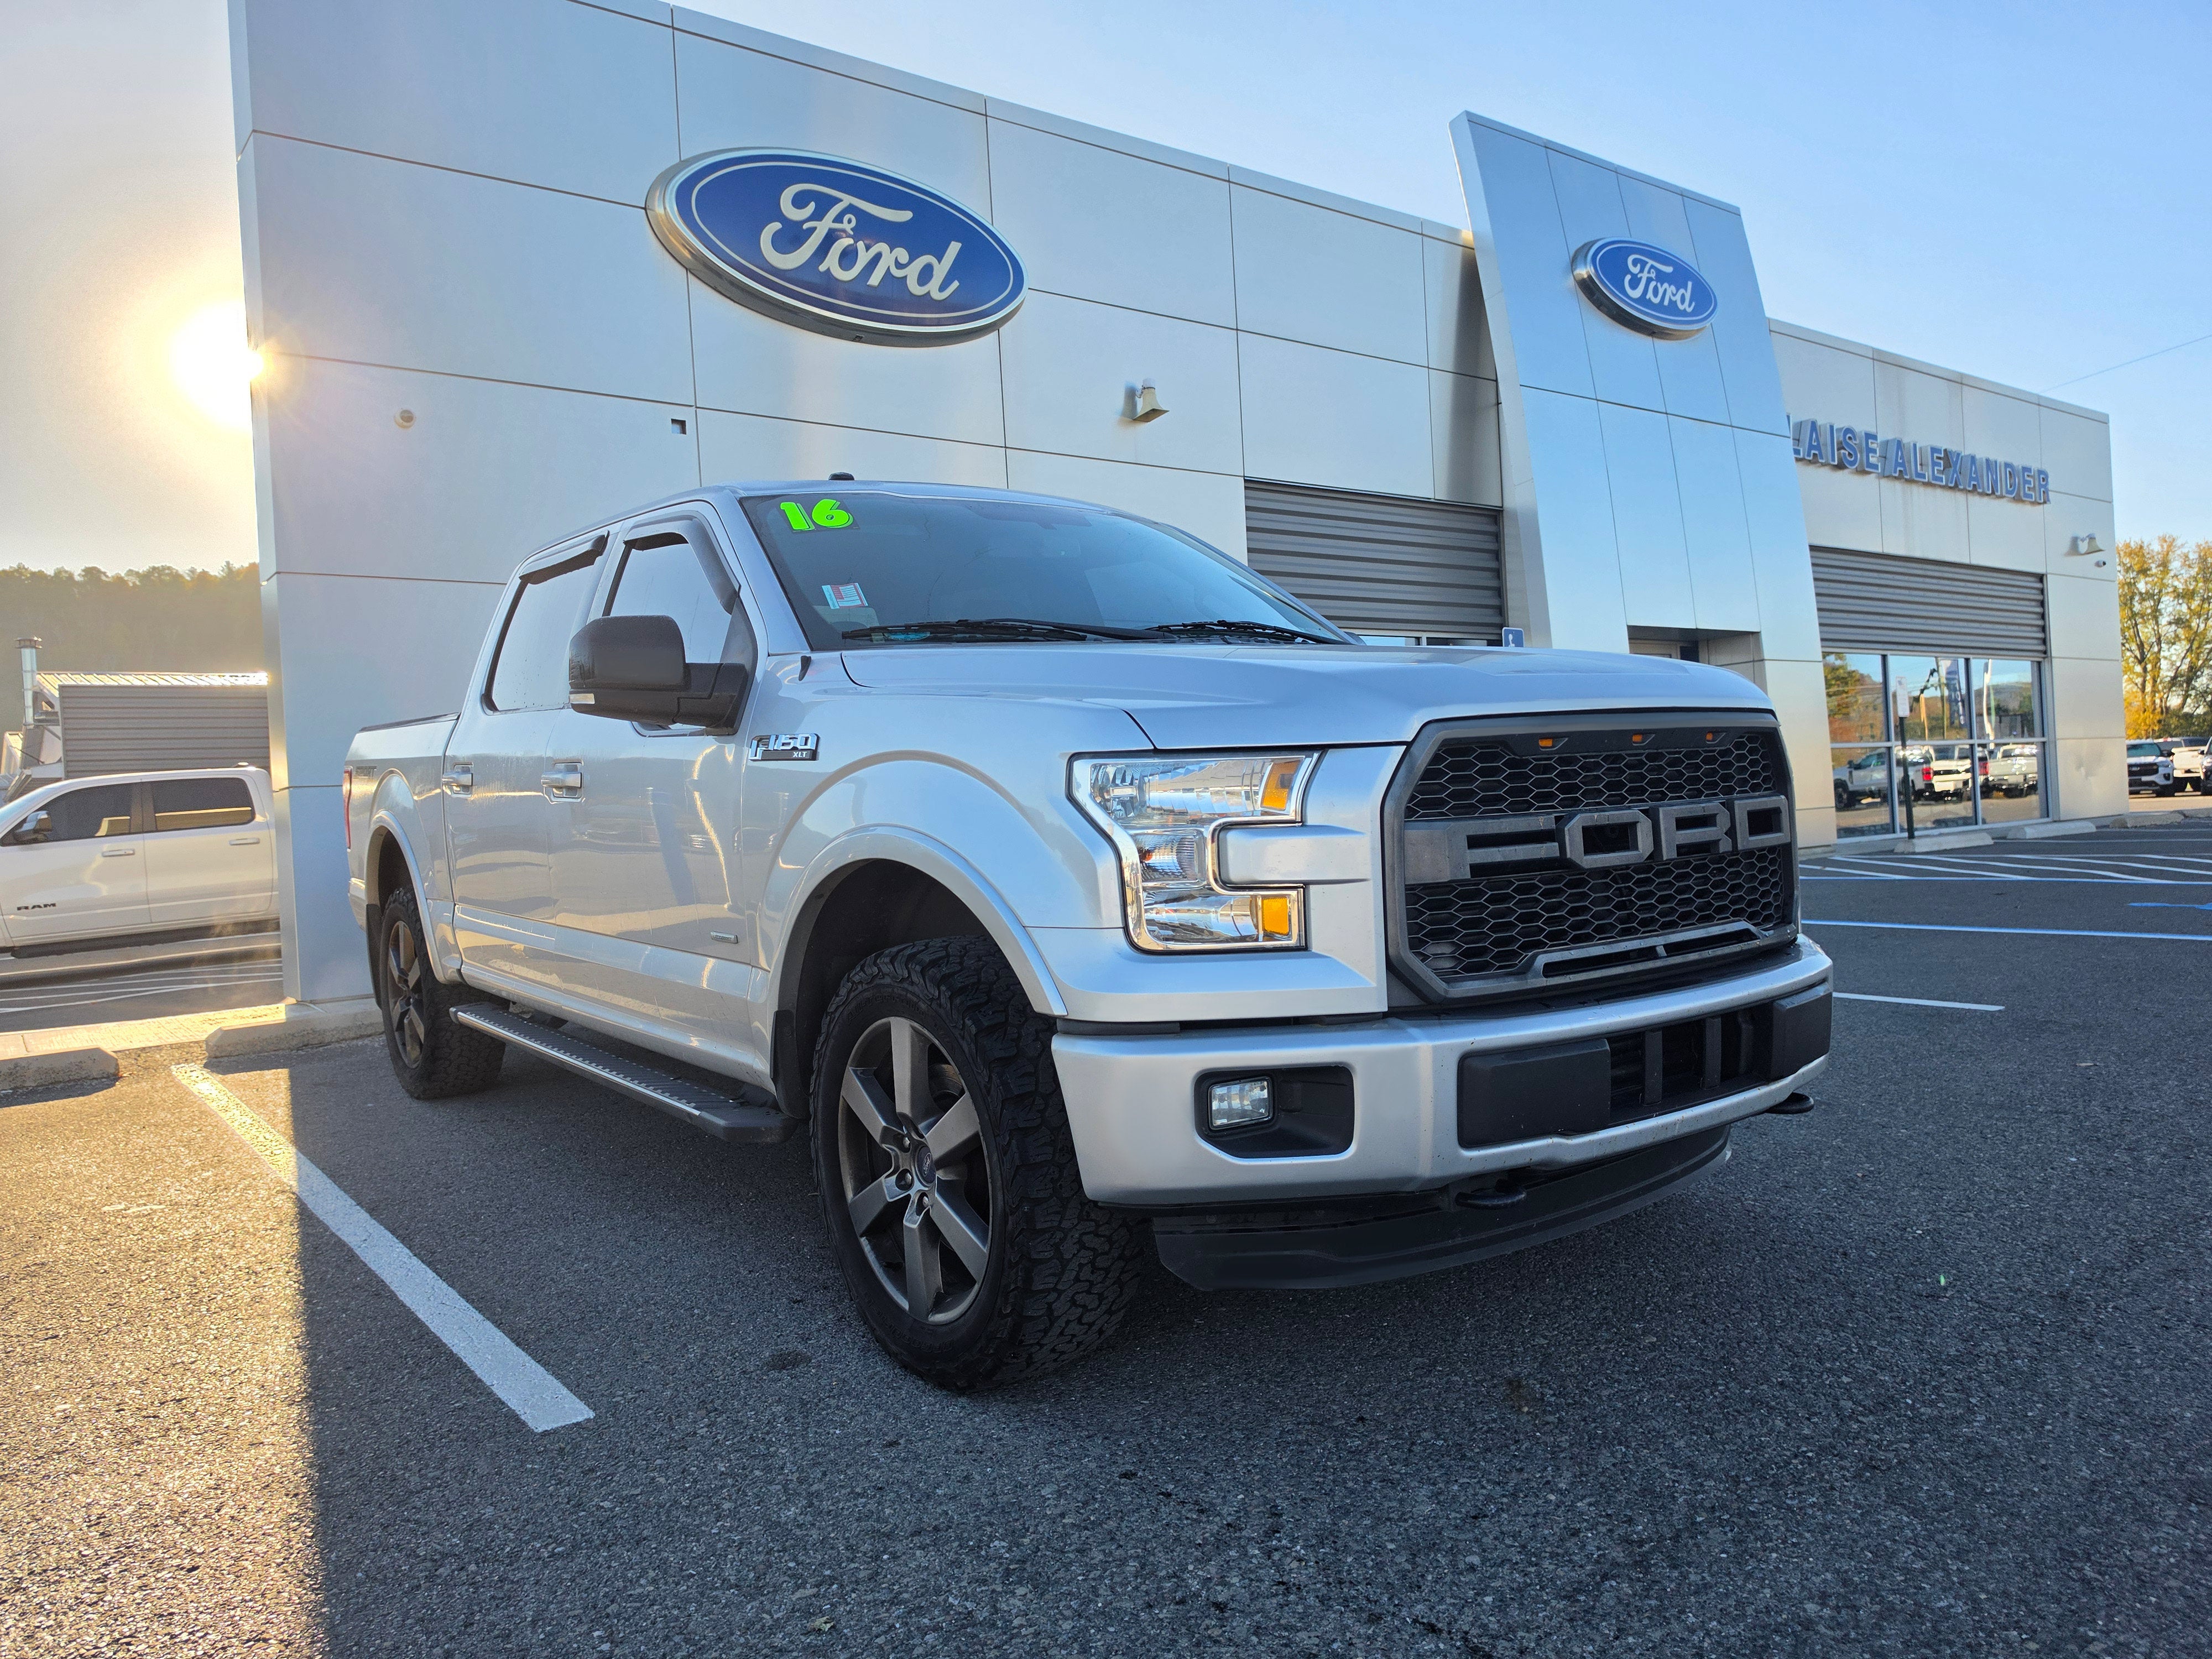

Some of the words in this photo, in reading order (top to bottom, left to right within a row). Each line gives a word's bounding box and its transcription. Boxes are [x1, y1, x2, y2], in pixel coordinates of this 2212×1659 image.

[760, 183, 962, 301] Ford
[1624, 254, 1695, 312] Ford
[1892, 438, 2051, 504] ALEXANDER
[780, 499, 853, 531] 16
[1446, 795, 1791, 880] FORD
